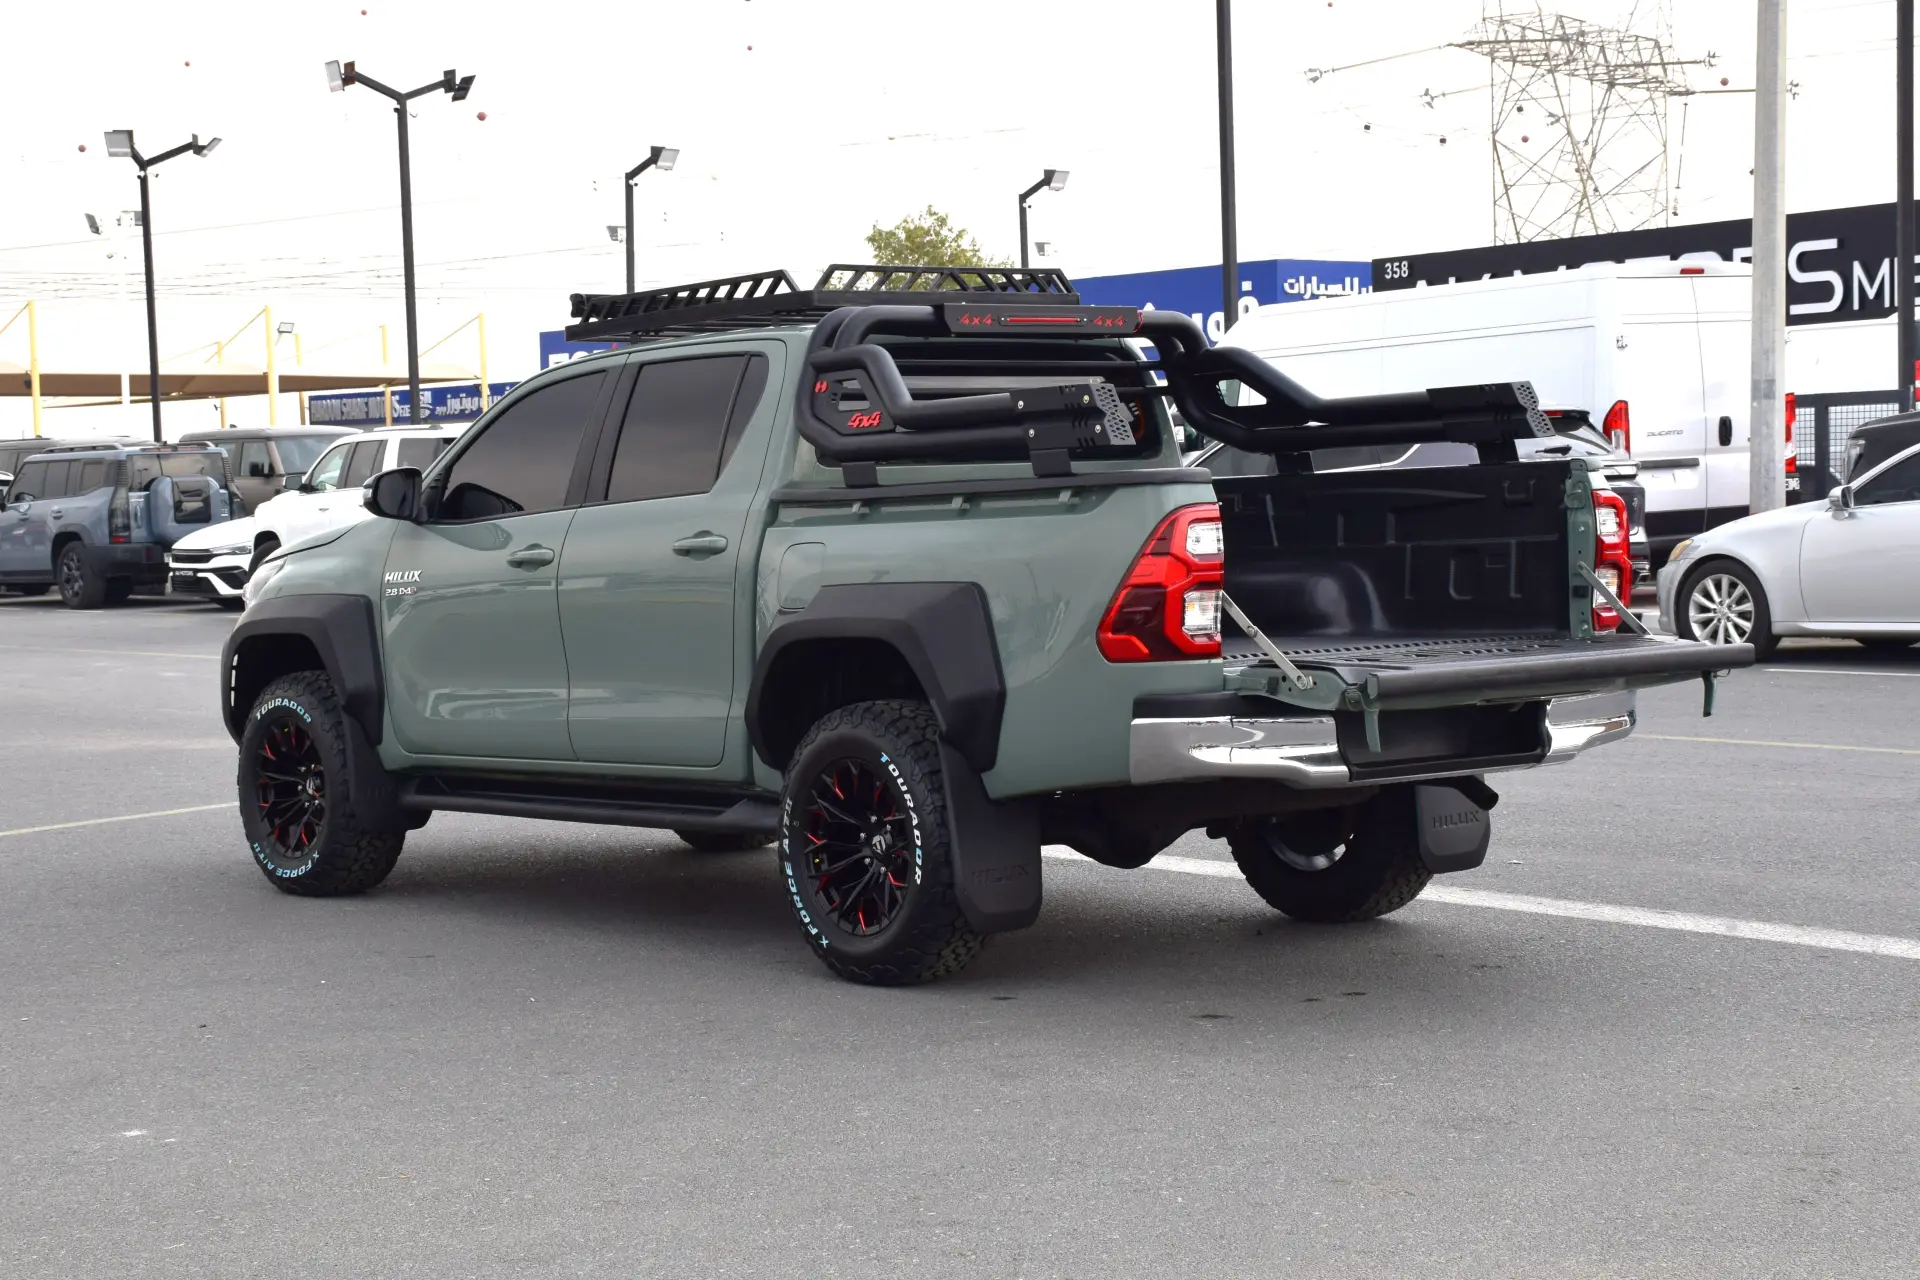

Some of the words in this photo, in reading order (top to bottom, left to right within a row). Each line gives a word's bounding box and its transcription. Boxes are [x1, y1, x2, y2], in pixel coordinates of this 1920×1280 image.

[1384, 260, 1409, 279] 358
[959, 312, 993, 326] 4x4
[1092, 315, 1125, 327] 4x4
[384, 570, 422, 583] HILUX
[255, 698, 312, 724] TOURADOR
[881, 752, 922, 885] TOURADOR
[1432, 810, 1480, 829] HILUX
[275, 859, 312, 878] FORCE
[784, 861, 819, 935] FORCE
